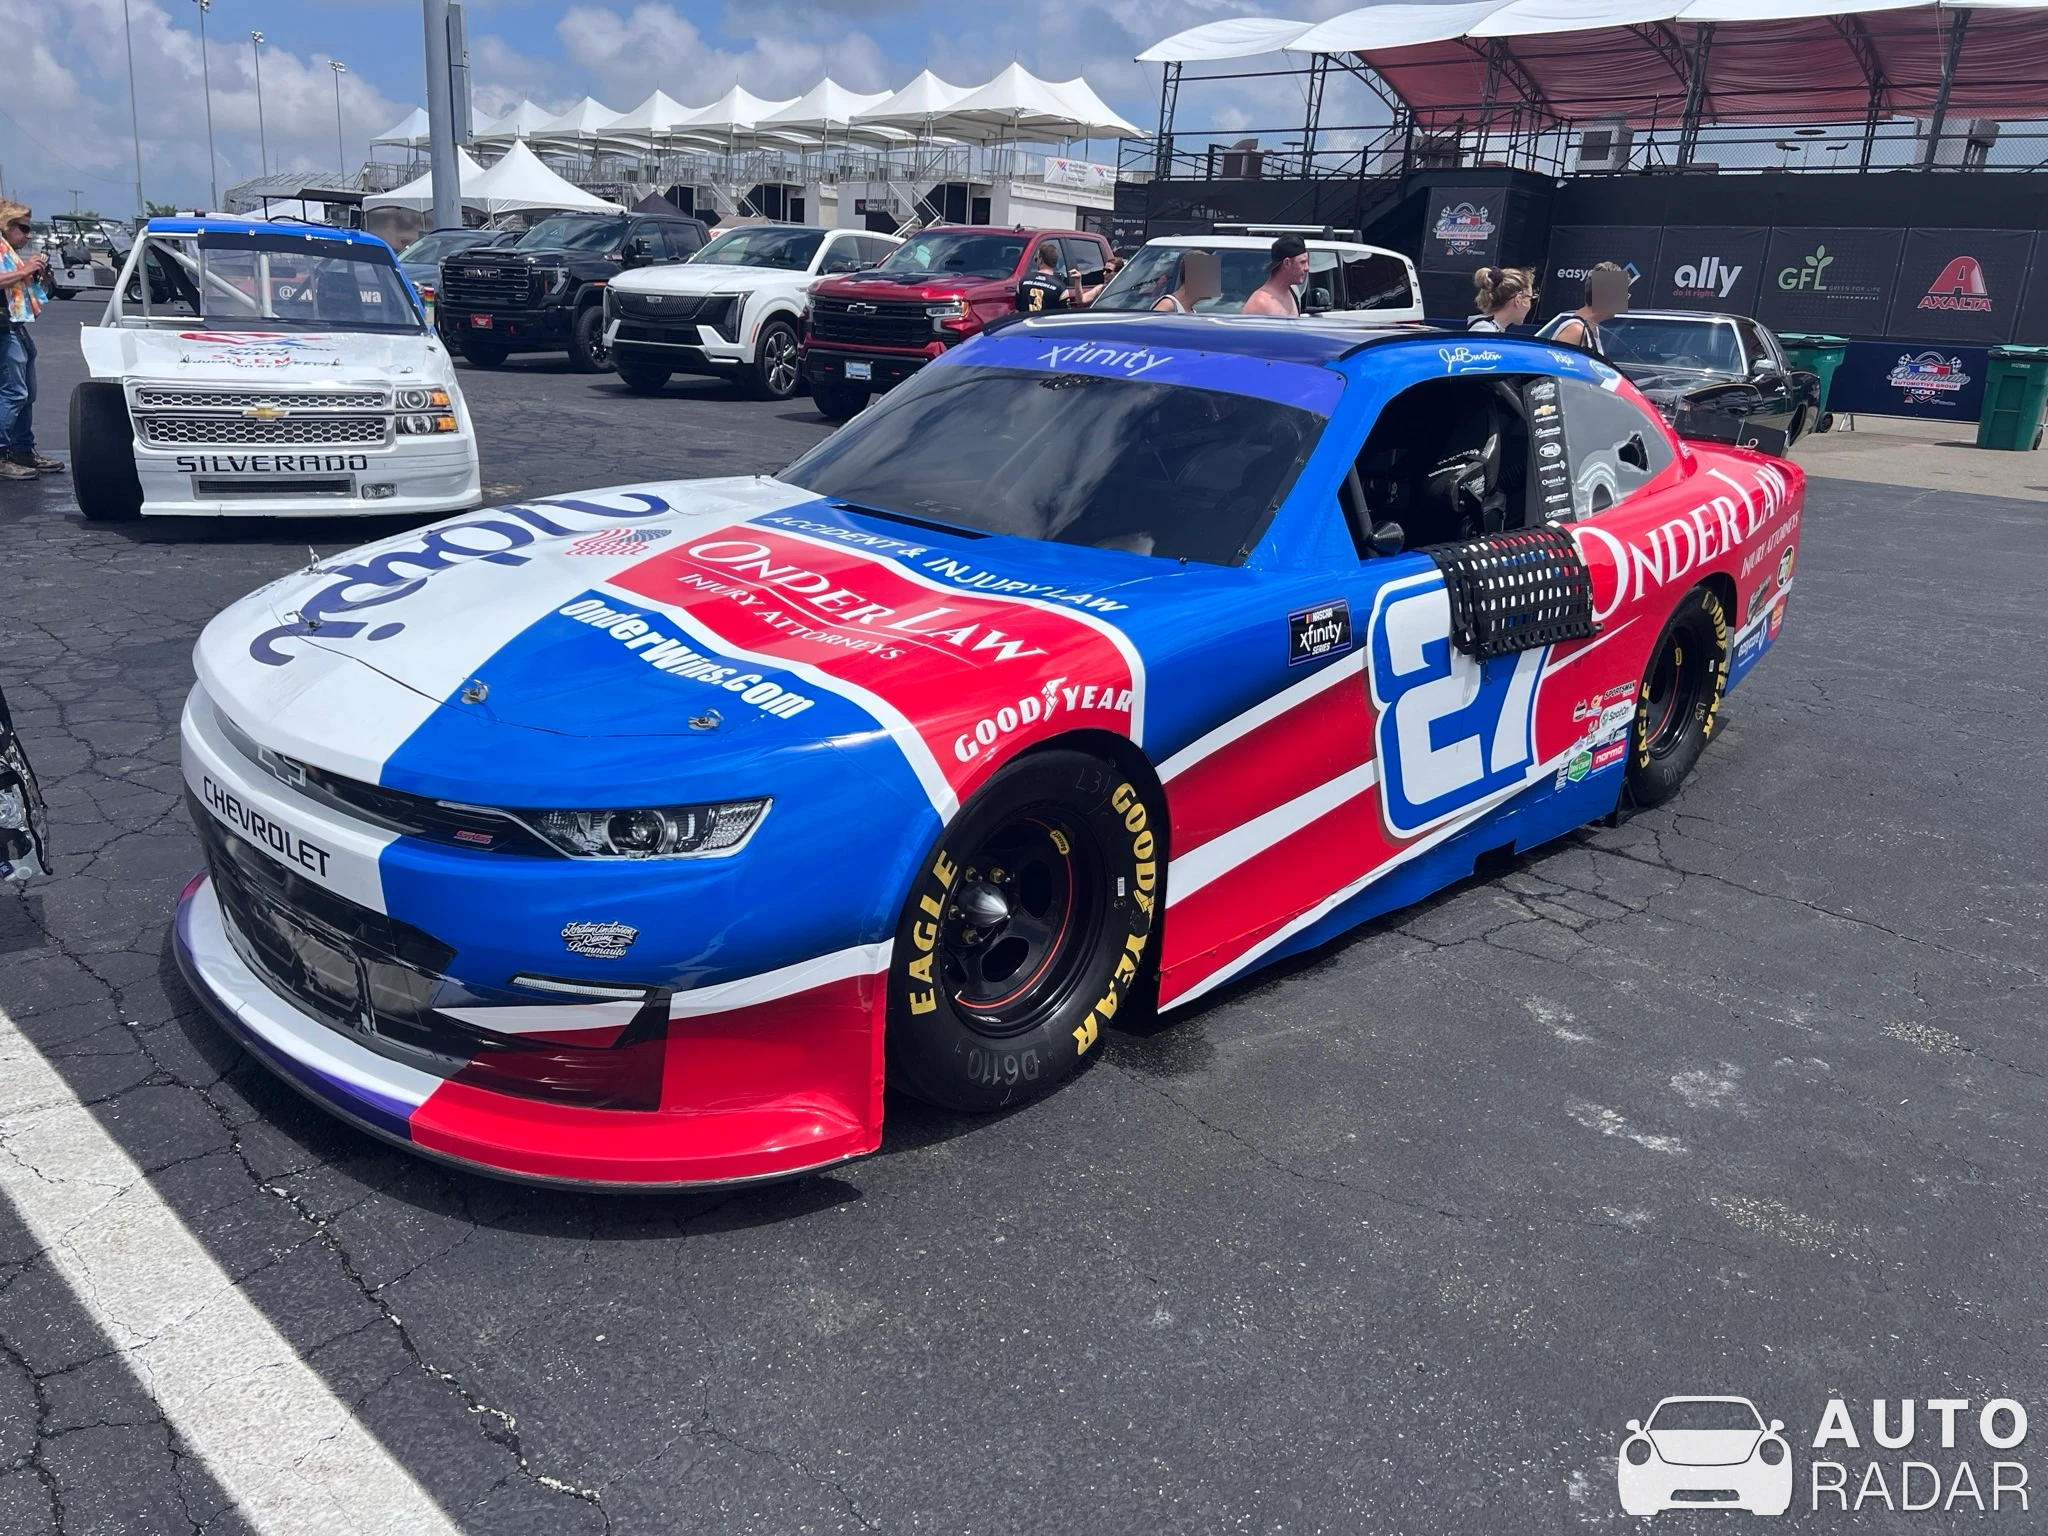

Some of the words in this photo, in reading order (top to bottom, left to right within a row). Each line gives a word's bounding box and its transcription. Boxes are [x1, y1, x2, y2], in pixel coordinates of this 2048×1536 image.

[465, 268, 499, 279] GMC
[1674, 256, 1743, 298] ally
[1777, 262, 1828, 290] GFL
[1029, 288, 1045, 312] 3
[1673, 288, 1684, 297] do
[1685, 289, 1692, 297] it
[1693, 289, 1716, 299] right.
[1917, 295, 1992, 312] AXALTA
[1037, 342, 1174, 376] xfinity
[1910, 388, 1936, 396] 500
[176, 455, 368, 473] SILVERADO
[762, 515, 898, 549] ACCIDENT
[897, 546, 927, 560] &
[922, 556, 1048, 596] INJURY
[1039, 583, 1130, 613] LAW
[676, 573, 766, 607] INJURY
[753, 609, 907, 661] ATTORNEYS
[1312, 607, 1333, 623] NASCAR
[1299, 619, 1343, 652] xfinity
[1311, 642, 1331, 655] SERIES
[203, 775, 331, 878] CHEVROLET
[453, 830, 494, 845] SS
[908, 850, 959, 1016] EAGLE
[566, 940, 627, 957] Bommarito
